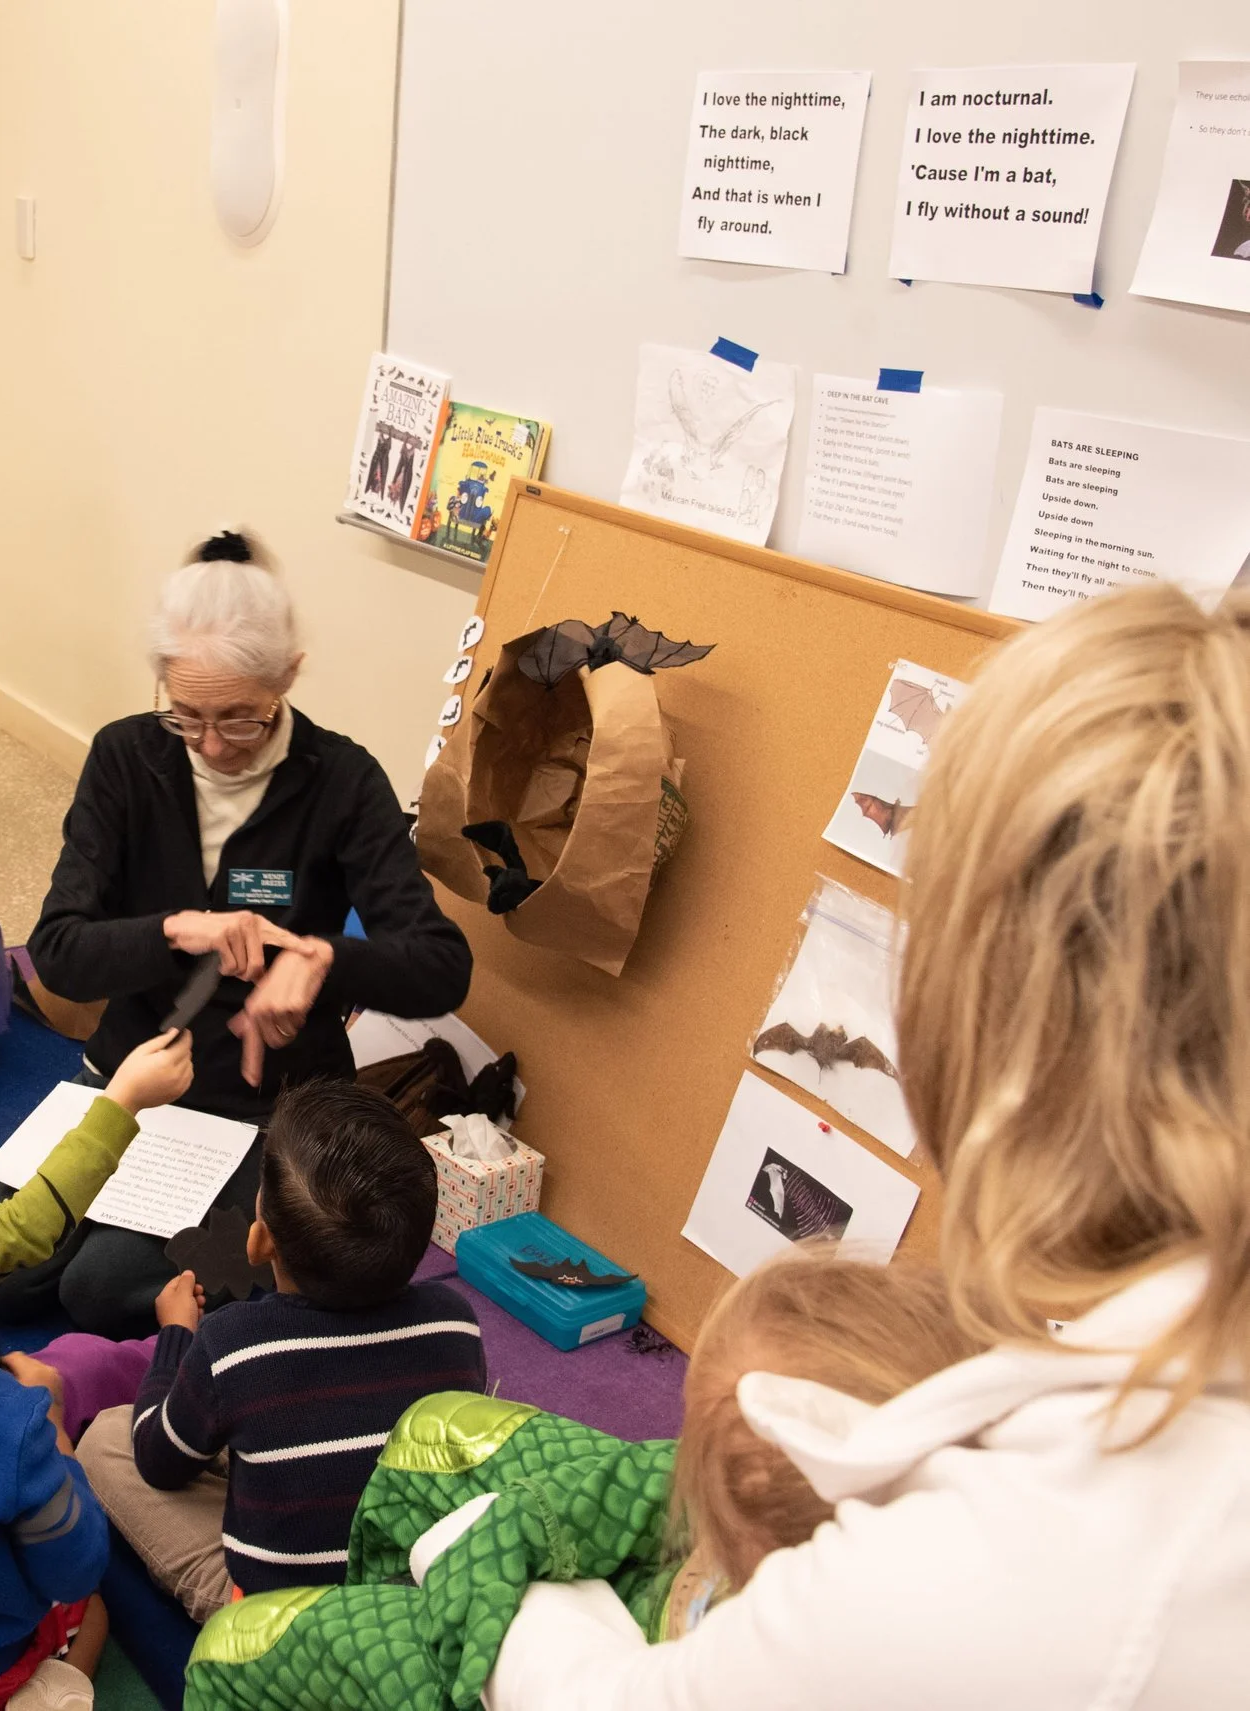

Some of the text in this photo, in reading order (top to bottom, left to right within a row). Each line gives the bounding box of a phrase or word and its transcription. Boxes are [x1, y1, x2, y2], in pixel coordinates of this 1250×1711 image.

[703, 92, 845, 110] I love the nighttime,
[920, 88, 1053, 106] I am nocturnal.
[700, 125, 809, 143] The dark, black
[915, 128, 1095, 148] I love the nighttime.
[704, 155, 774, 173] nighttime,
[911, 165, 1057, 187] 'Cause I'm a bat,
[692, 186, 821, 207] And that is when I
[906, 201, 1089, 224] I fly without a sound!
[698, 216, 772, 234] fly around.
[380, 386, 426, 416] AMAZING
[827, 390, 842, 399] DEEP
[850, 393, 860, 401] THE
[874, 396, 889, 405] CAVE
[386, 403, 417, 430] BATS
[1051, 439, 1139, 461] BATS ARE SLEEPING
[1048, 457, 1121, 479] Bats are sleeping
[1045, 475, 1119, 497] Bats are sleeping
[1042, 492, 1099, 510] Upside down.
[1038, 510, 1094, 528] Upside down
[1034, 528, 1155, 559] Sleeping in the morning sun.
[1030, 545, 1065, 560] Waiting
[1066, 552, 1079, 561] for
[1081, 555, 1096, 565] the
[1097, 559, 1120, 571] night
[1121, 565, 1131, 573] to
[1026, 562, 1050, 574] Then
[1051, 568, 1080, 580] they'll
[1081, 573, 1093, 584] fly
[1094, 578, 1106, 586] all
[1021, 580, 1045, 591] Then
[1047, 586, 1076, 598] they'll
[1078, 591, 1090, 601] fly
